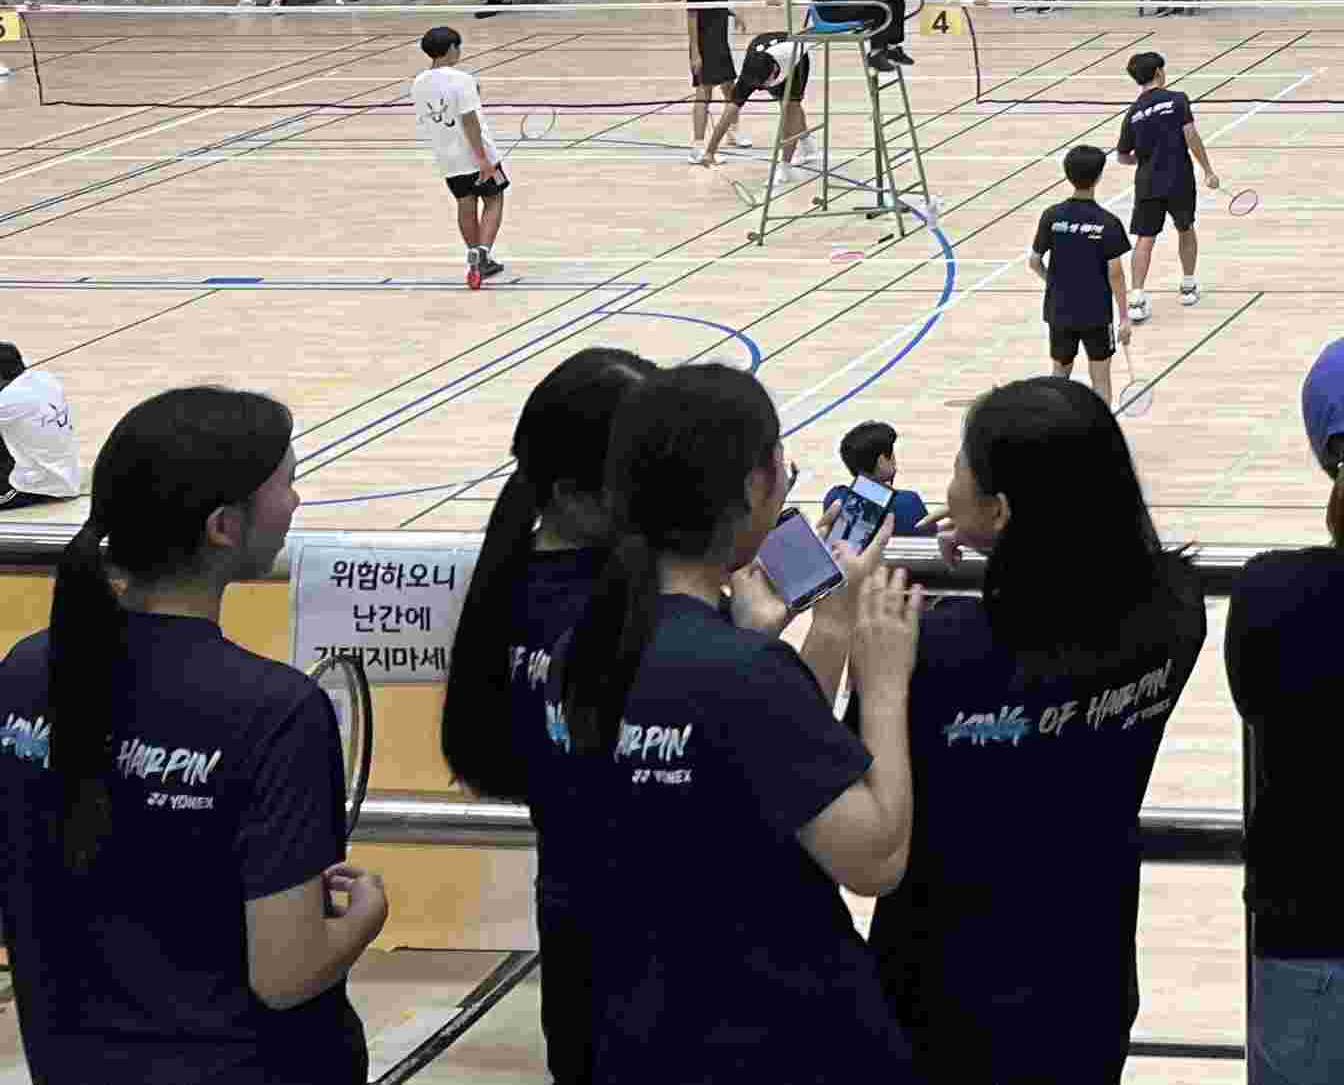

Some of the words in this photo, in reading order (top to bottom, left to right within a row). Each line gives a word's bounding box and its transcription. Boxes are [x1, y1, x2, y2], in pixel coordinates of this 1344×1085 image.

[931, 10, 950, 35] 4
[329, 560, 456, 592] 위험하오니
[352, 603, 432, 633] 난간에
[313, 646, 448, 673] 기대지마세
[1038, 700, 1078, 738] OF
[116, 736, 223, 787] HAIRPIN
